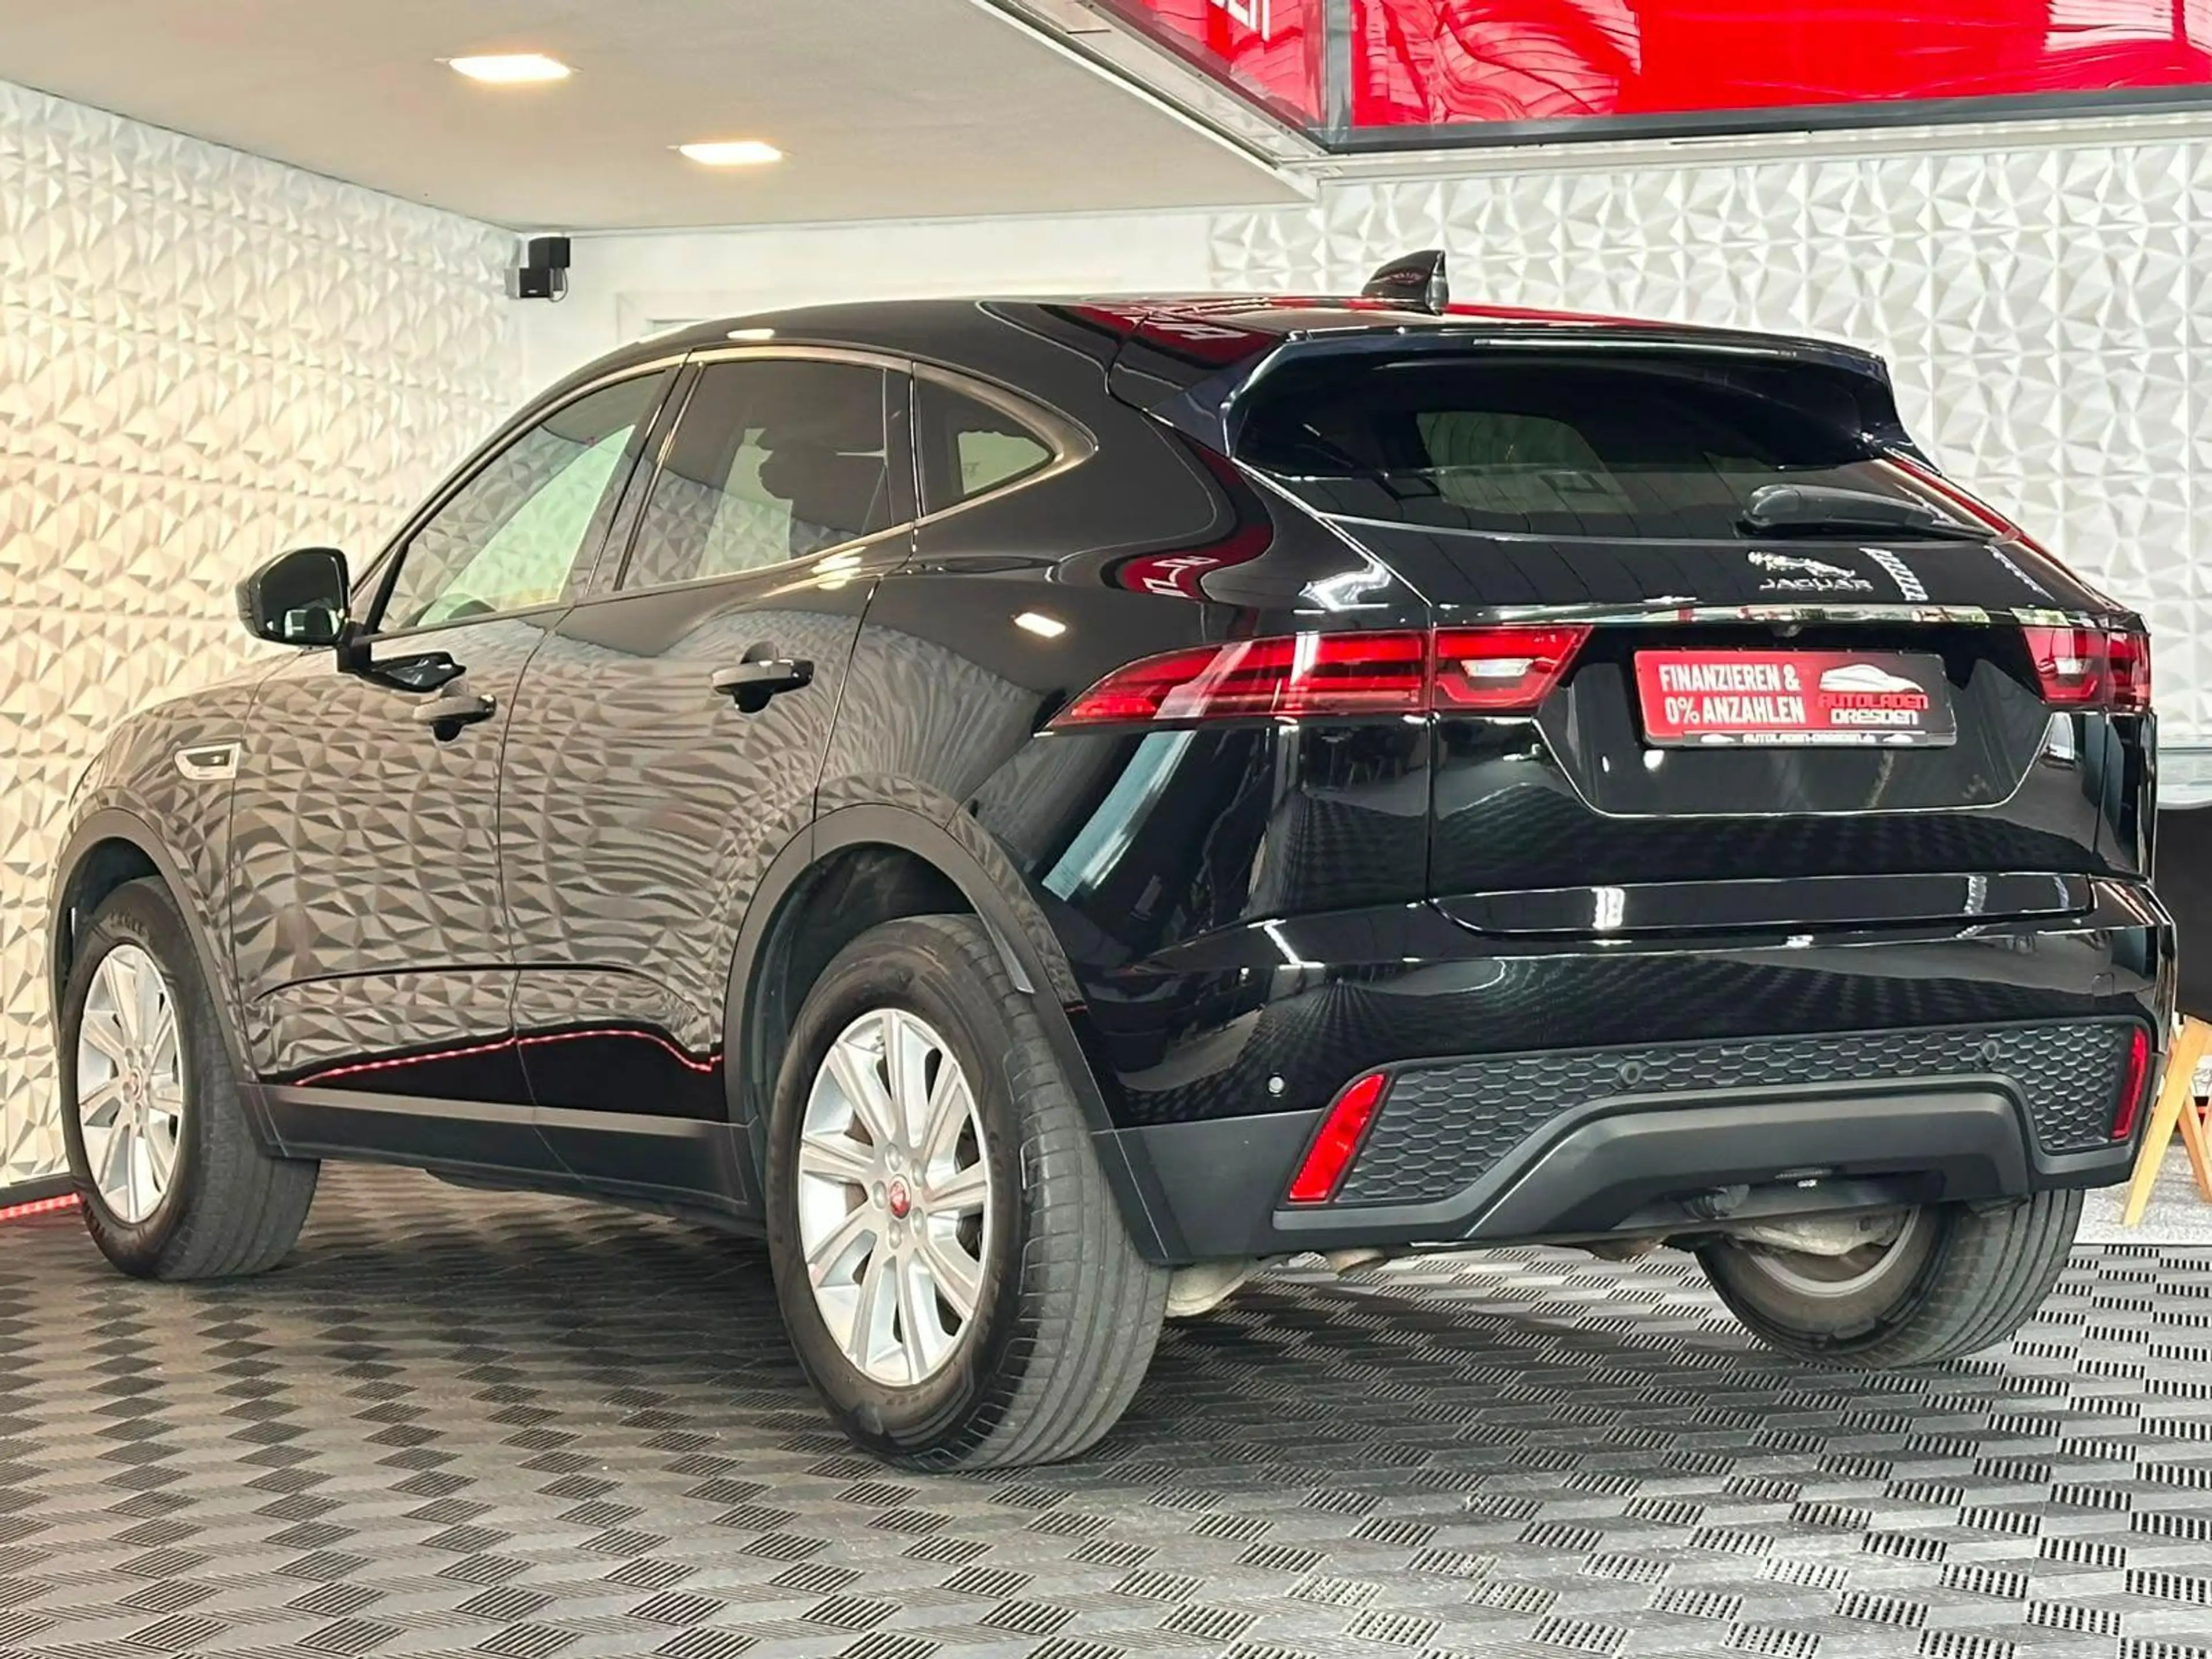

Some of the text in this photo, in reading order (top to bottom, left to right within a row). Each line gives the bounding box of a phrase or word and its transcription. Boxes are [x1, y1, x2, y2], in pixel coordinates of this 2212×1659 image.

[1759, 578, 1874, 592] JAGUAR
[1658, 664, 1801, 692] FINANZIEREN &
[1818, 694, 1929, 709] AUTOLADEN
[1665, 696, 1806, 724] 0% ANZAHLEN
[1831, 709, 1919, 724] DRESDEN
